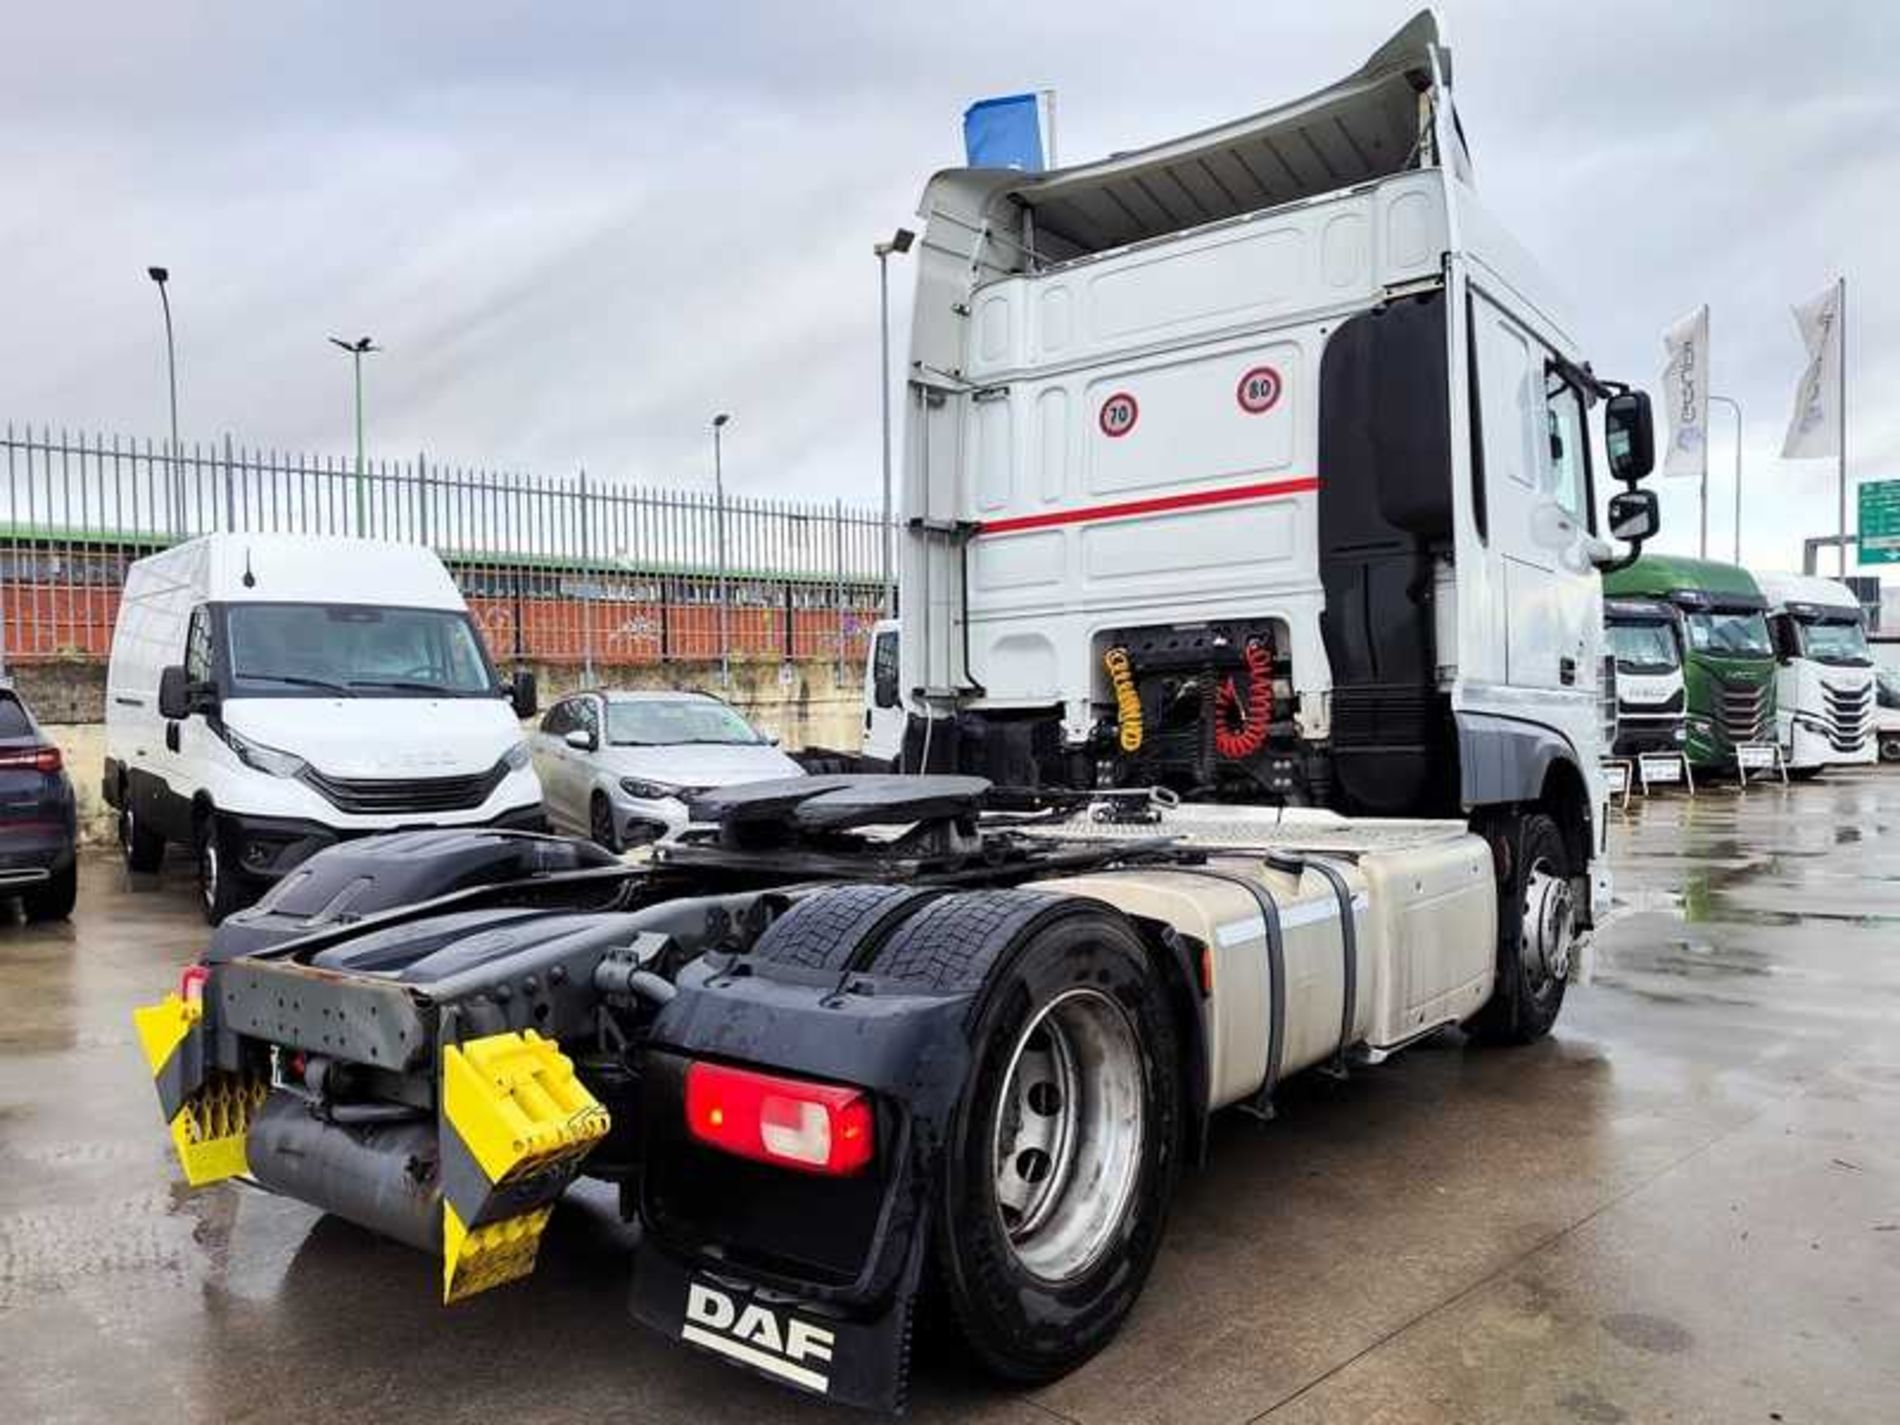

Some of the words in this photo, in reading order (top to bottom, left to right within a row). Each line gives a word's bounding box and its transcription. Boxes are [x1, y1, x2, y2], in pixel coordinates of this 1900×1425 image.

[1249, 379, 1271, 400] 80
[1109, 405, 1129, 425] 70
[686, 1283, 835, 1360] DAF
